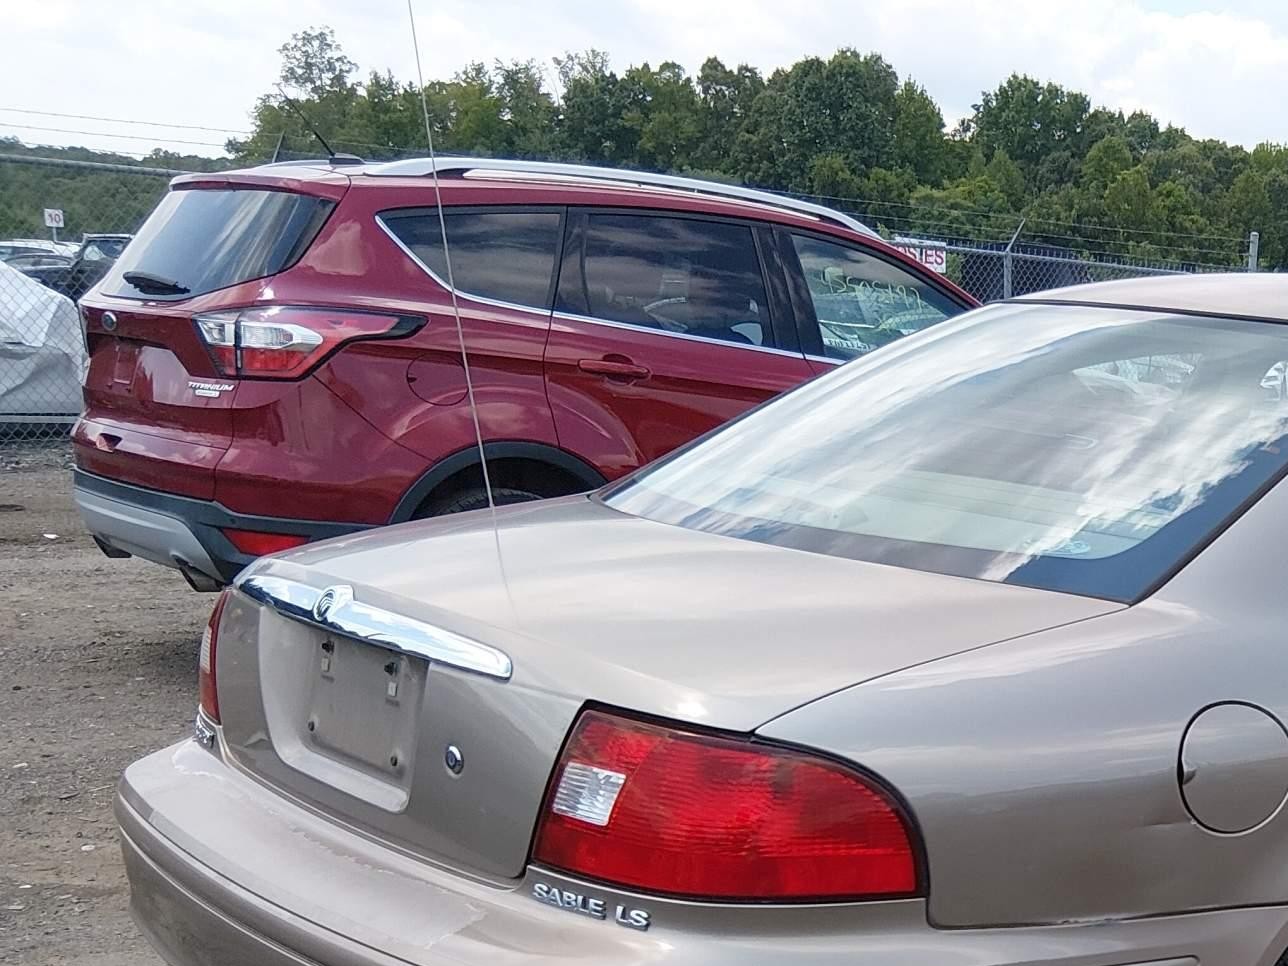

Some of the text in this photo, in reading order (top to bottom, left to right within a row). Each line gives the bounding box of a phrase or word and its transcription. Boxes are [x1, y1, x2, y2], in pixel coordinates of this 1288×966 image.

[47, 213, 60, 224] 10
[187, 381, 235, 391] TITANIUM
[533, 883, 651, 931] SABLE LS
